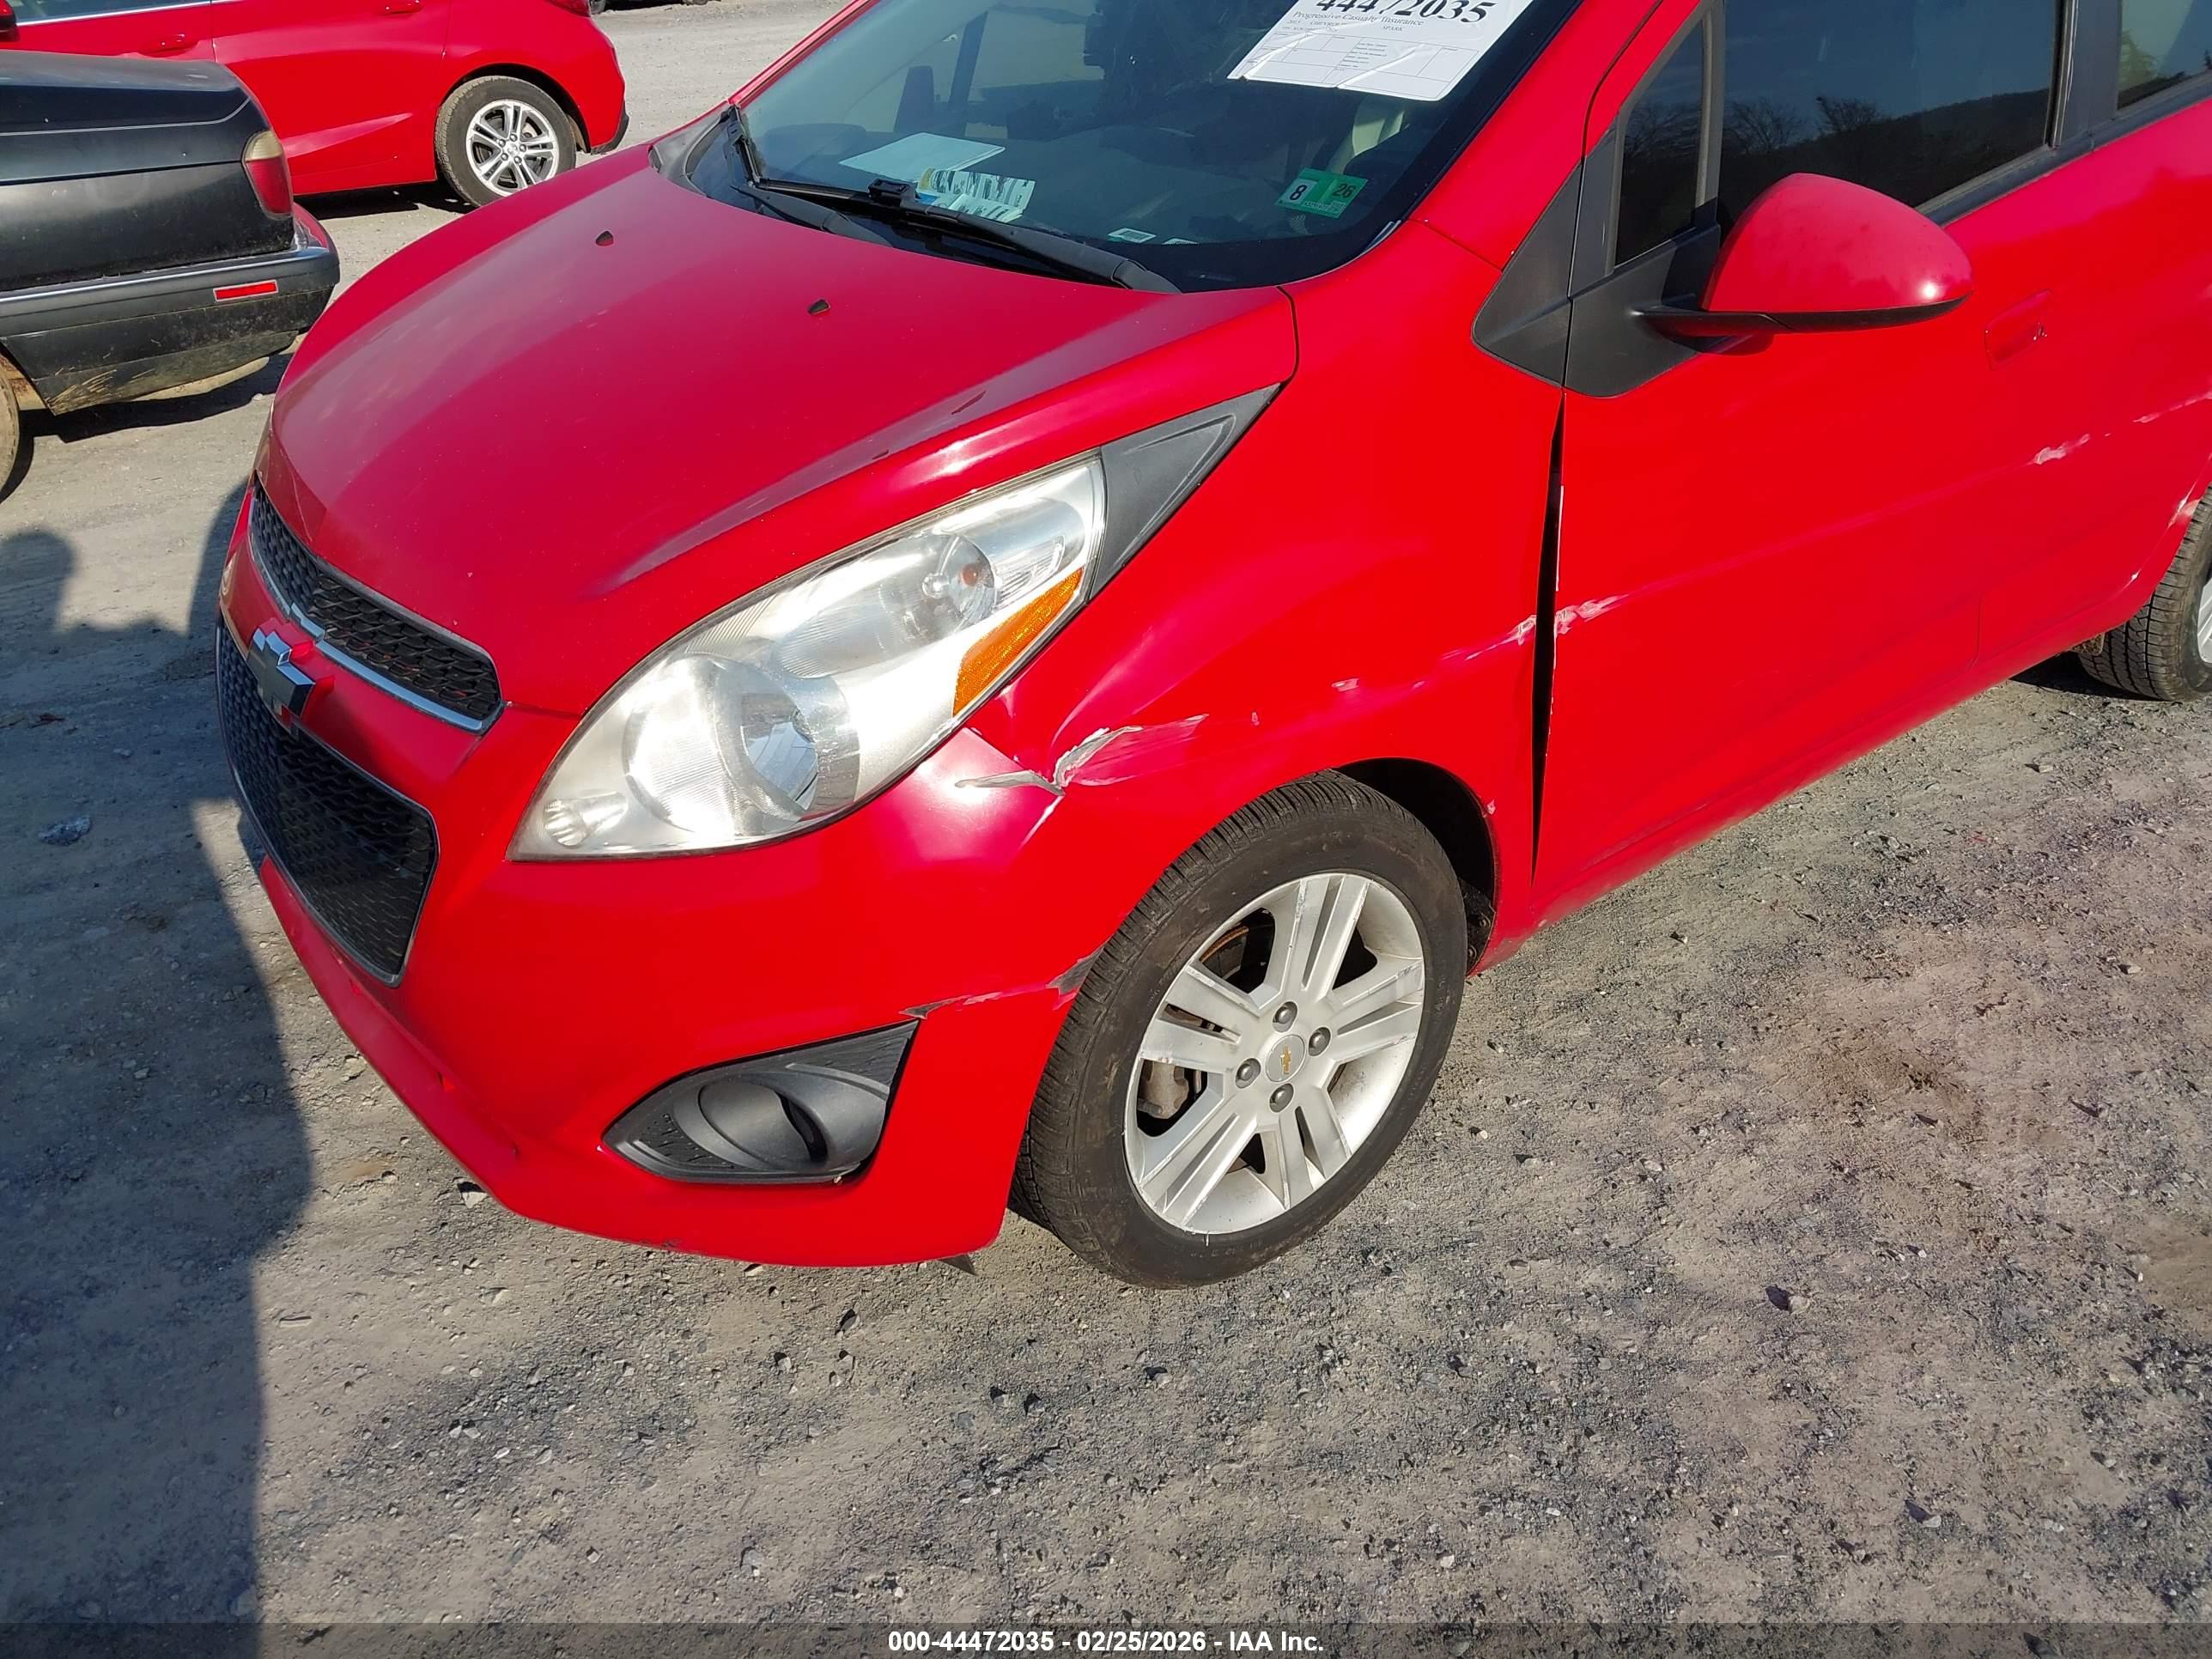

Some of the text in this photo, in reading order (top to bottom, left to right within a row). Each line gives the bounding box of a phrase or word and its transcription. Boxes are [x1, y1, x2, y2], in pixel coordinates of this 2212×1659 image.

[1292, 10, 1425, 26] Progressive Casualty Insurance
[1289, 184, 1308, 201] 8
[1332, 183, 1357, 198] 26
